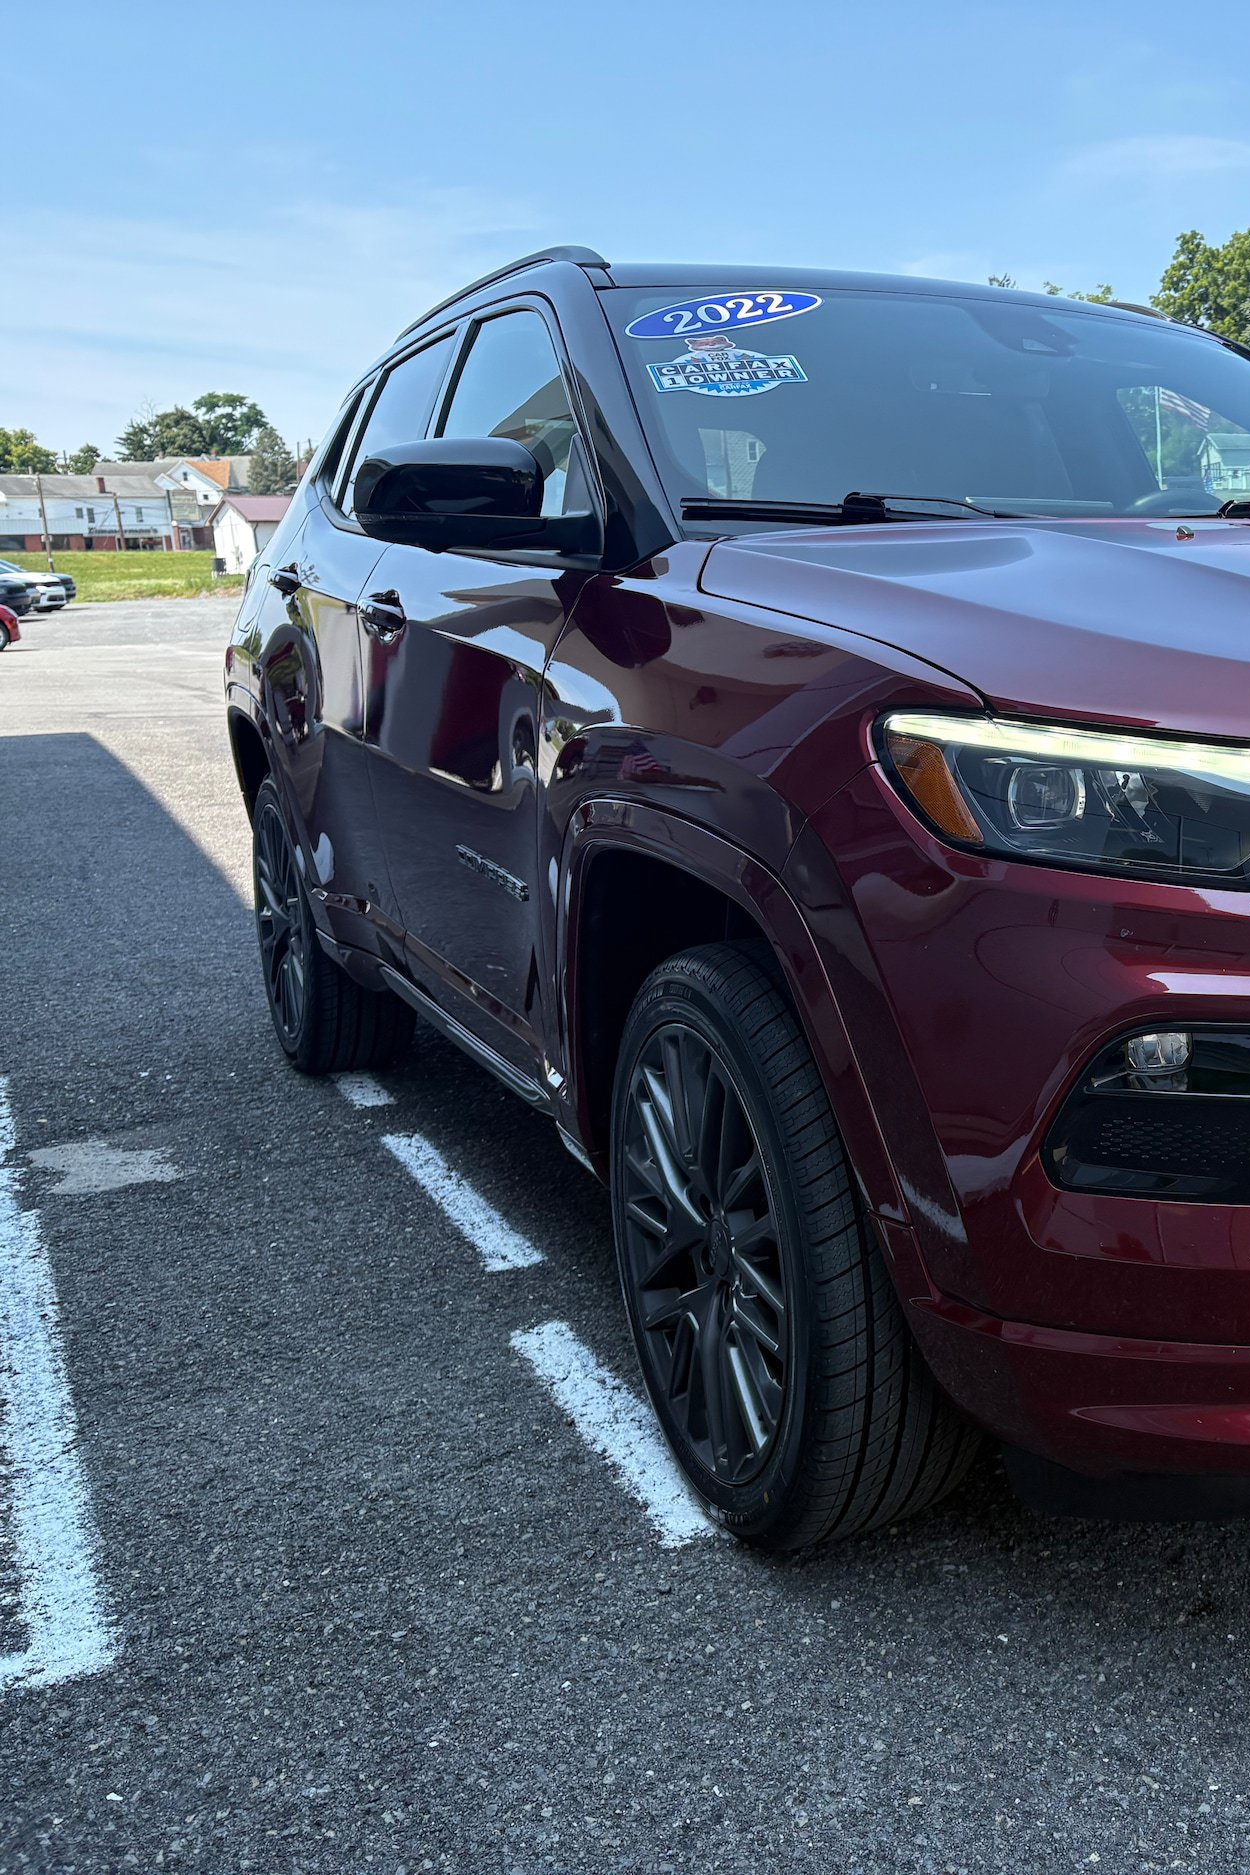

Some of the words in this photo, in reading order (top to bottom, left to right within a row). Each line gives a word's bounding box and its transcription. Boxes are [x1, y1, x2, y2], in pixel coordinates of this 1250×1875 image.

[663, 293, 793, 334] 2022
[661, 359, 788, 375] CARFAX
[664, 377, 681, 386] 1
[692, 369, 793, 384] OWNER
